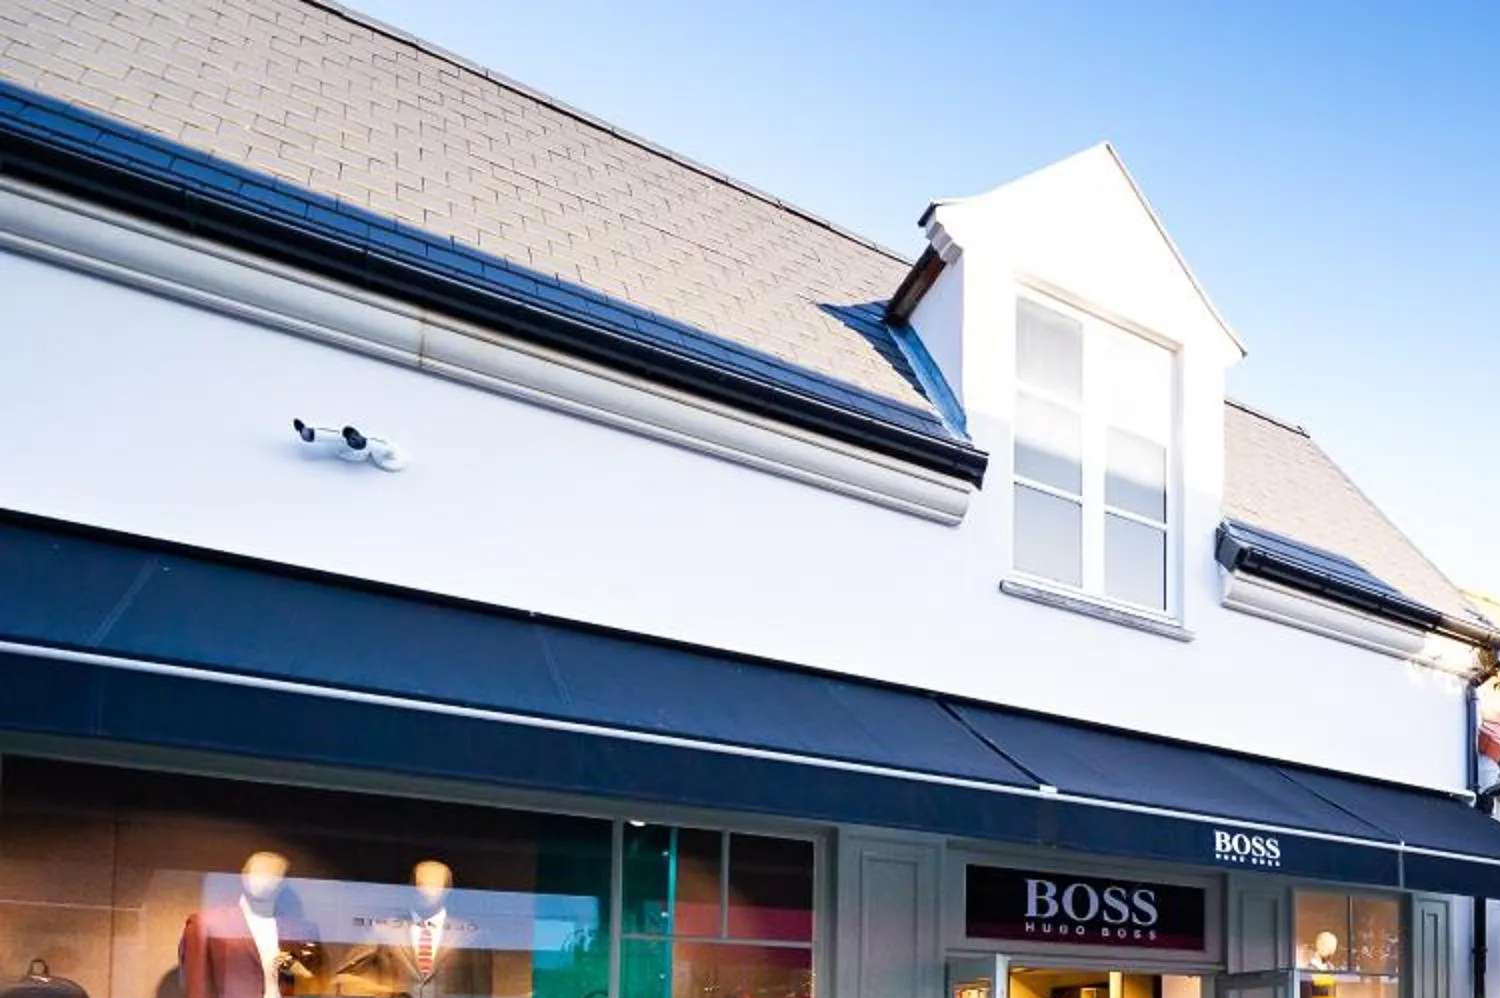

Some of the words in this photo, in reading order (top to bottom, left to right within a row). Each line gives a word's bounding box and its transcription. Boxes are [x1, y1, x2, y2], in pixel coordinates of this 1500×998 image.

[1215, 830, 1281, 859] BOSS
[1024, 878, 1158, 926] BOSS
[1025, 921, 1085, 935] HUGO
[1101, 927, 1157, 940] BOSS
